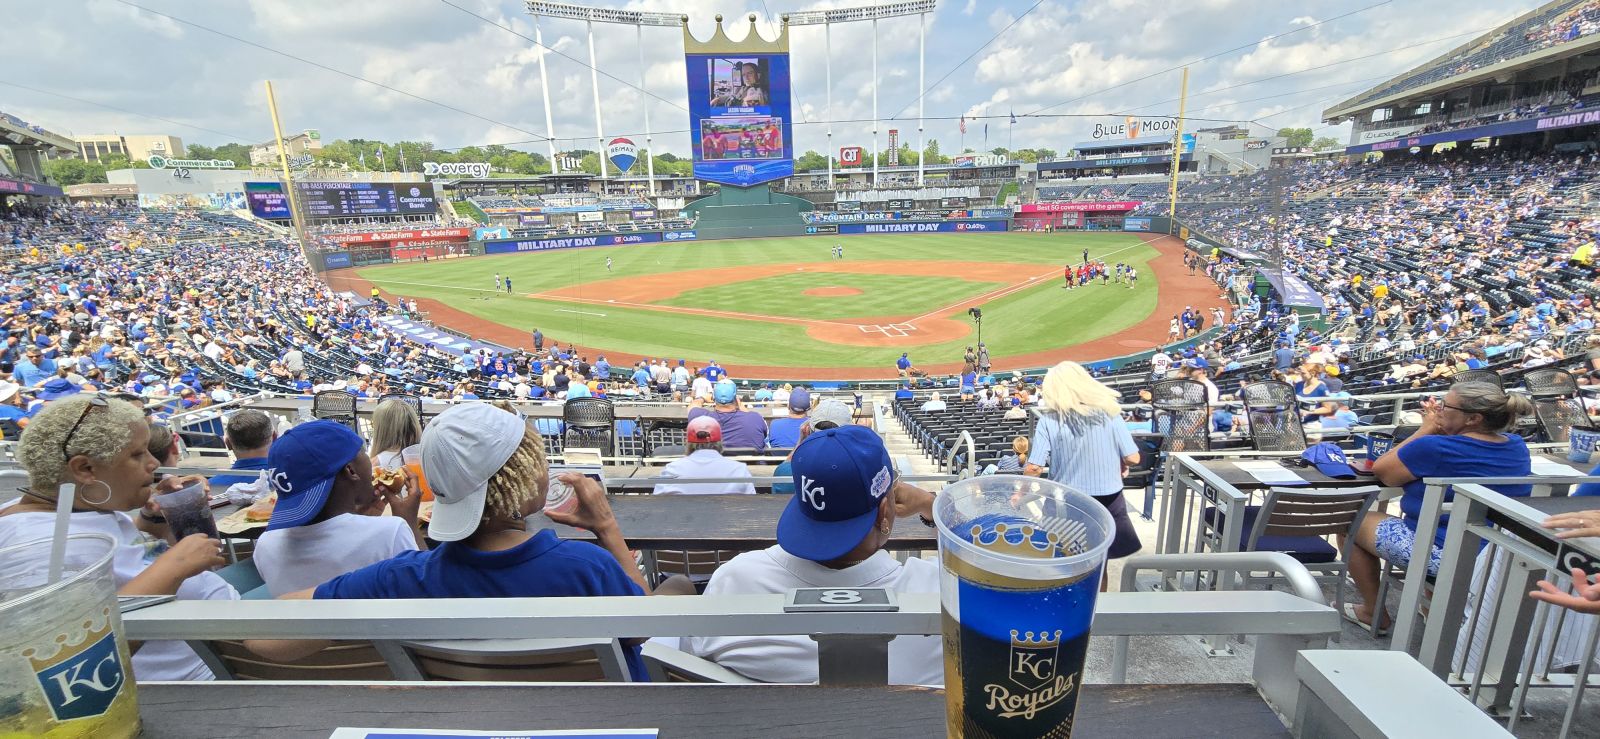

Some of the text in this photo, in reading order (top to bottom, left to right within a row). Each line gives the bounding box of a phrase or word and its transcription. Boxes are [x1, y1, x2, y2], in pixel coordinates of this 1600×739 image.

[1142, 120, 1179, 132] MOON
[1536, 110, 1600, 129] MILITARY DA
[842, 149, 858, 162] QT
[975, 155, 1006, 166] PATIO
[1095, 158, 1131, 166] MILITARY
[561, 156, 582, 170] Lite
[173, 168, 191, 179] 42
[441, 164, 490, 177] evergy
[823, 212, 862, 220] FOUNTAIN
[866, 223, 939, 232] MILITARY DAY
[517, 237, 597, 251] MILITARY DAY
[1327, 453, 1344, 464] KC
[801, 475, 825, 511] KC
[820, 589, 862, 604] 8
[1015, 651, 1053, 680] KC
[48, 651, 120, 707] KC
[983, 671, 1078, 720] Royals
